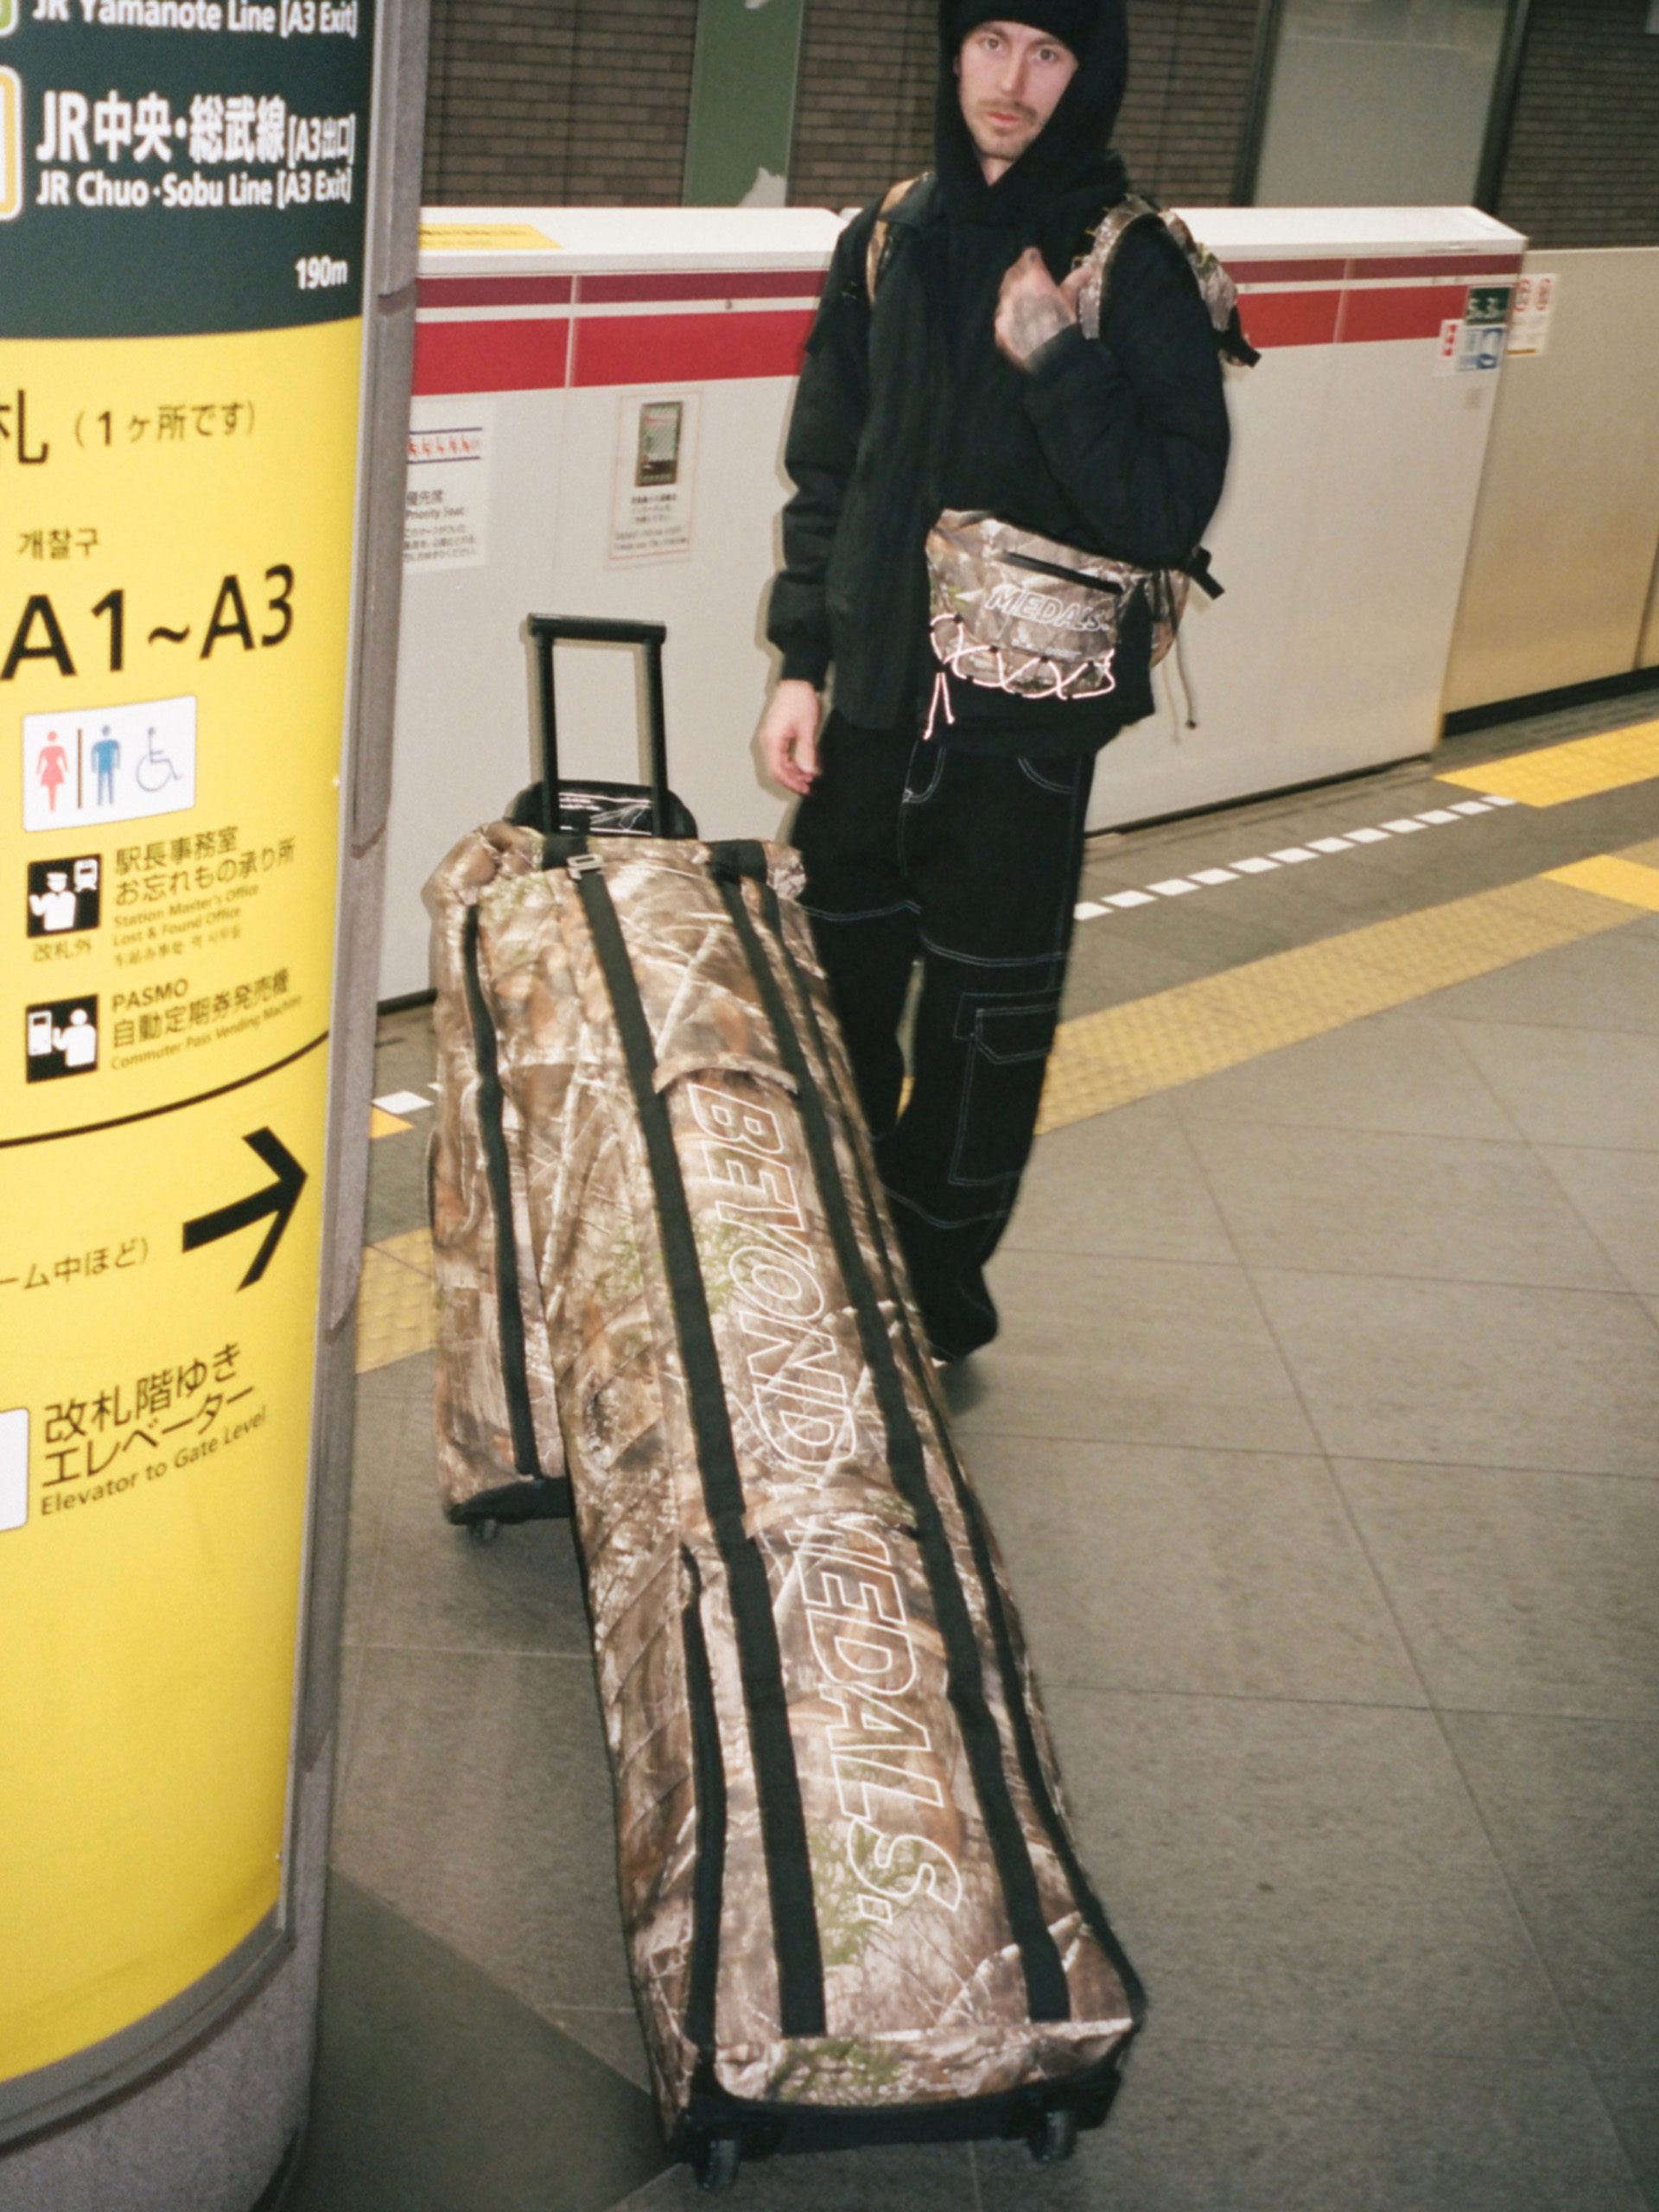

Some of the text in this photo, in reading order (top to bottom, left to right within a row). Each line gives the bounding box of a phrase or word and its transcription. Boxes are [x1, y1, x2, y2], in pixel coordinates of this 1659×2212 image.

[81, 0, 222, 30] Yamanote
[227, 0, 276, 33] Line
[36, 169, 70, 207] JR
[229, 173, 273, 207] Line
[295, 255, 348, 290] 190m
[17, 527, 99, 561] 개찰구
[115, 825, 238, 876] 駅長事務室
[115, 836, 296, 906] お忘れもの承り所
[114, 908, 165, 929] Station
[111, 977, 189, 1013] PASMO
[687, 1082, 858, 1465] BEYOND
[44, 1342, 240, 1444] 改札階ゆき
[41, 1385, 255, 1488] エレベーター
[41, 1404, 267, 1516] Elevator to Gate Level
